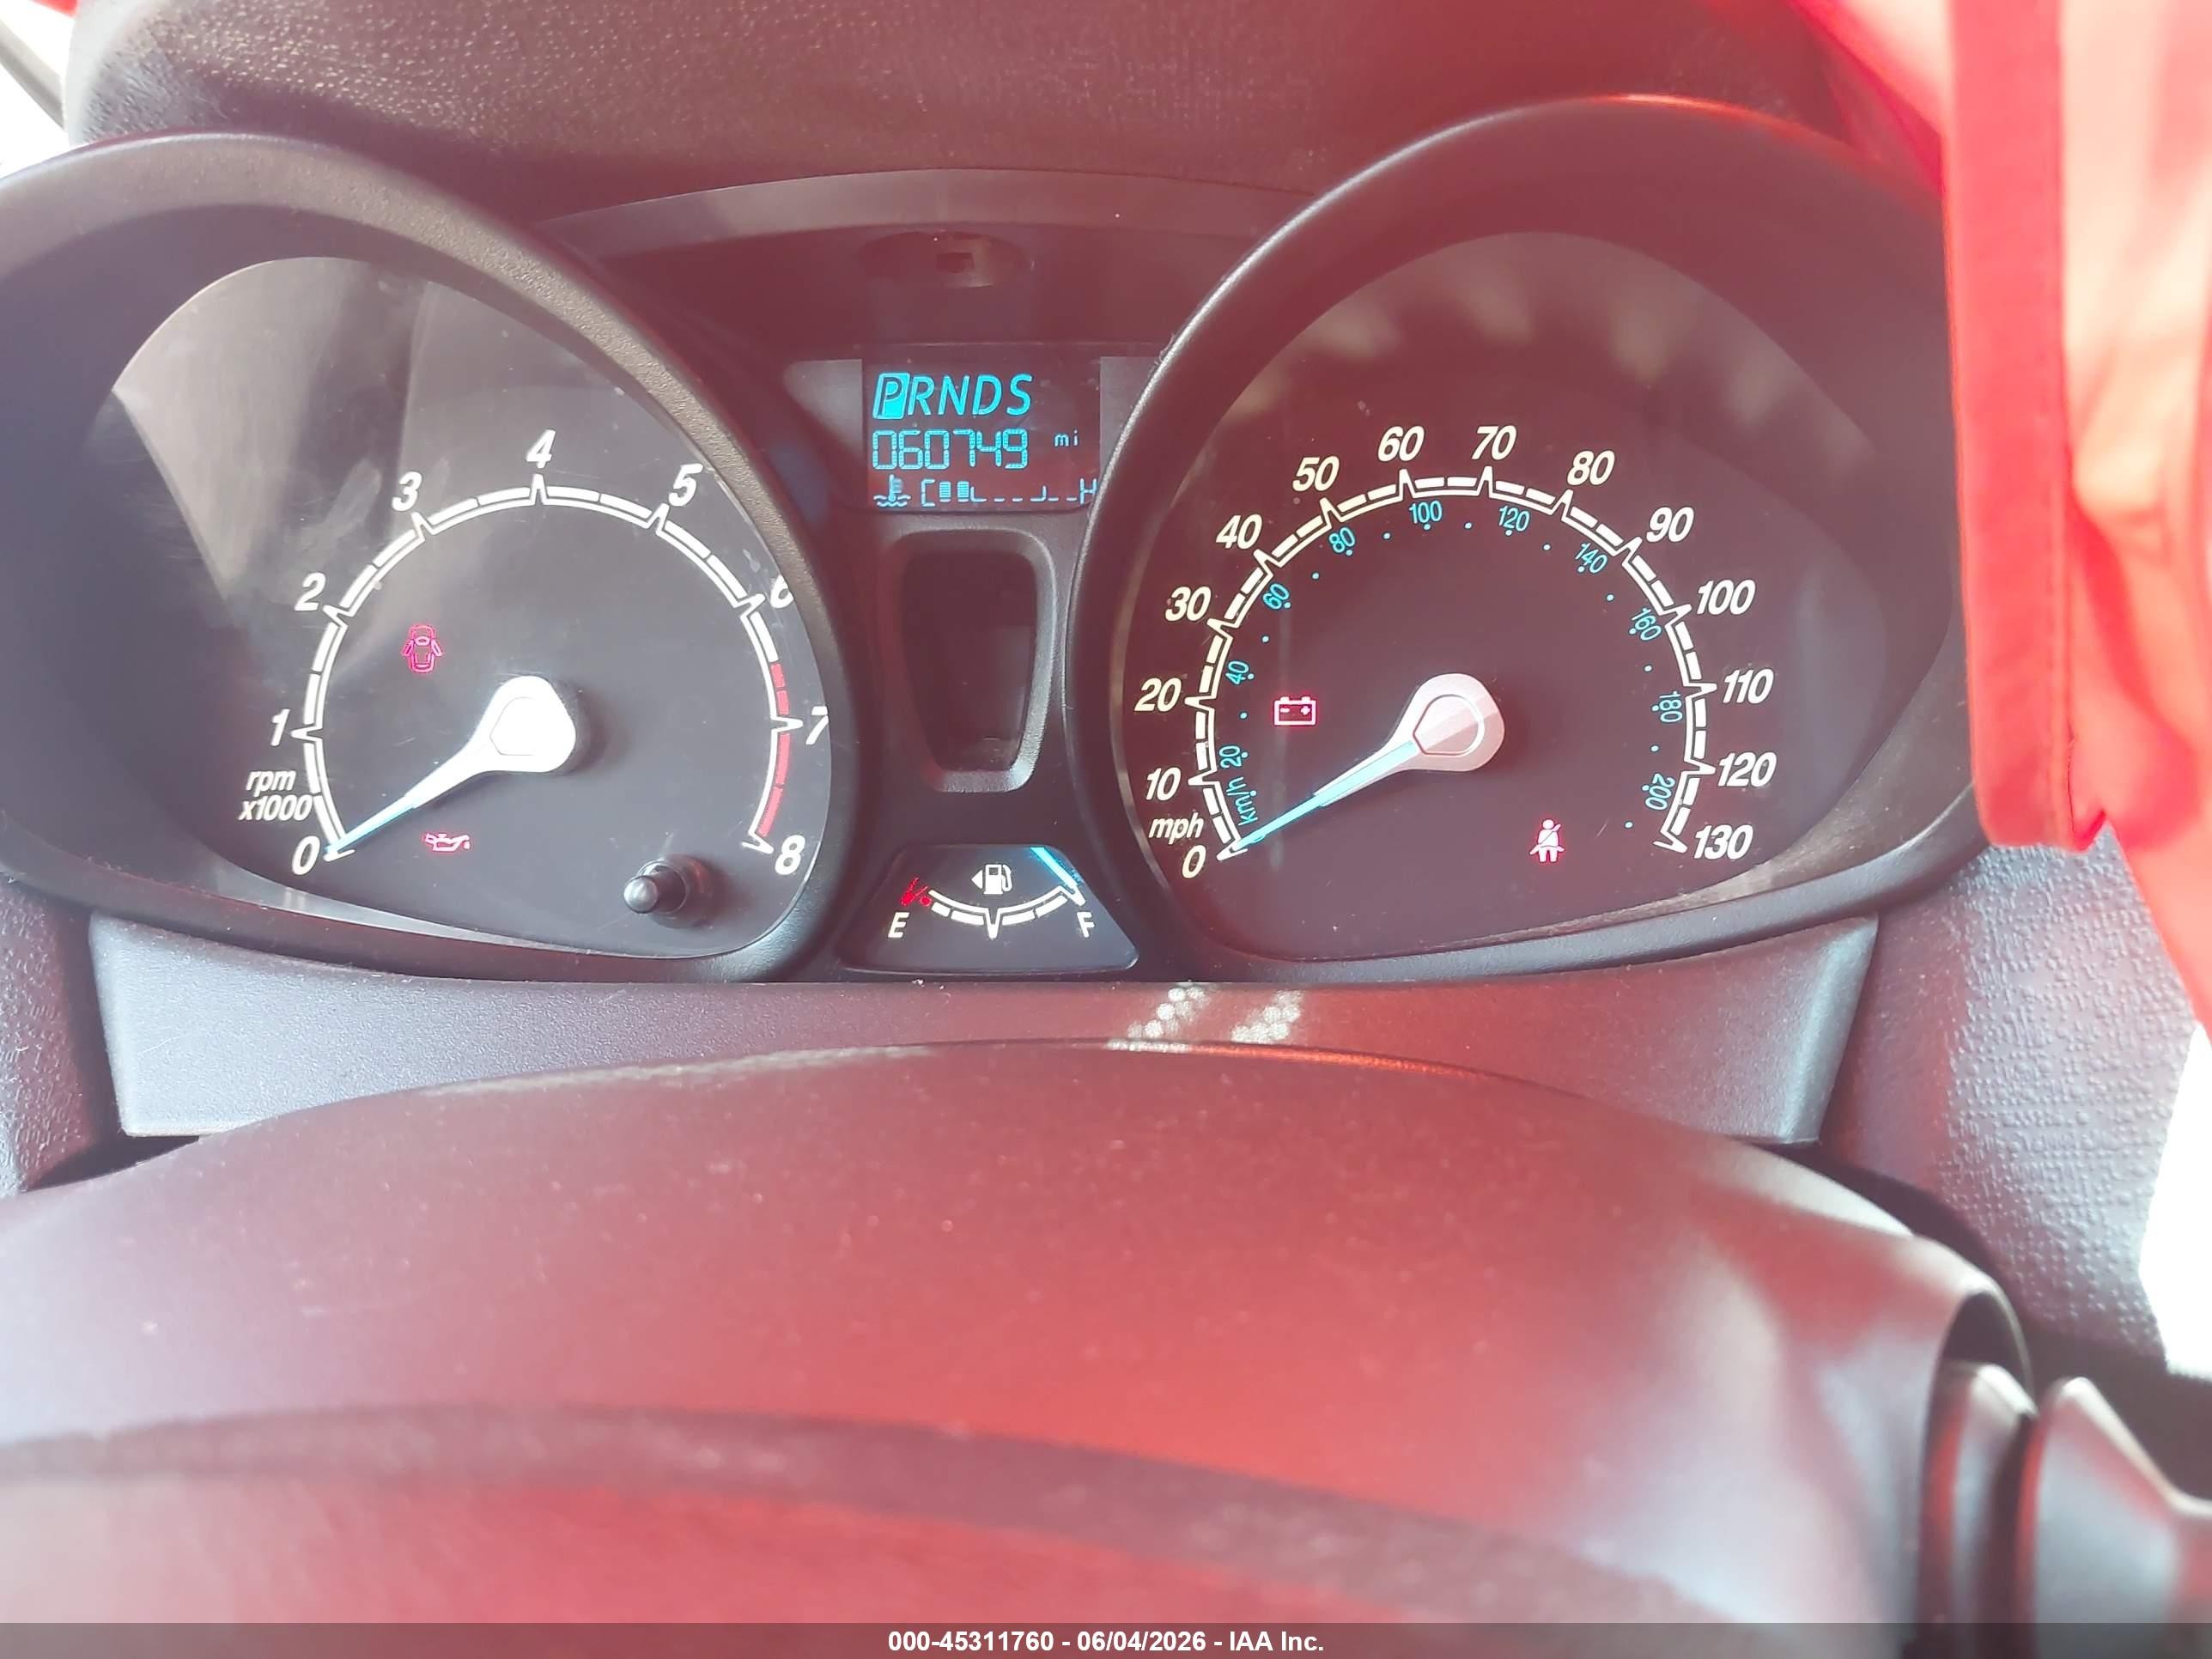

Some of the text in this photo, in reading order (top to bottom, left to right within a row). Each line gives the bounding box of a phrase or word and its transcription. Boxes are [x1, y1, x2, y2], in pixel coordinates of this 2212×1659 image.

[526, 429, 556, 468] 4
[872, 428, 1079, 470] 060749 mi
[1377, 426, 1425, 462] 60
[1471, 425, 1517, 460] 70
[668, 464, 703, 506] 5
[1292, 456, 1340, 492] 50
[1566, 450, 1615, 486] 80
[392, 471, 422, 512] 3
[1408, 500, 1443, 524] 100
[1498, 505, 1531, 532] 120
[1646, 506, 1694, 543] 90
[1216, 514, 1262, 550] 40
[1328, 526, 1356, 554] 80
[1575, 542, 1607, 574] 140
[295, 573, 325, 611] 2
[1164, 586, 1212, 622] 30
[1261, 583, 1290, 611] 60
[1696, 579, 1756, 616] 100
[1632, 607, 1662, 641] 160
[1225, 660, 1249, 685] 40
[1723, 668, 1774, 704] 110
[1133, 677, 1182, 712] 20
[1658, 691, 1683, 723] 180
[270, 708, 289, 745] 1
[805, 706, 829, 744] 7
[1218, 744, 1242, 769] 20
[1717, 751, 1778, 787] 120
[246, 770, 295, 795] rpm
[1146, 767, 1182, 801] 10
[1645, 773, 1675, 811] 200
[239, 795, 313, 821] x1000
[1225, 776, 1258, 826] km/h
[1148, 812, 1204, 844] mph
[1693, 824, 1753, 860] 130
[292, 836, 320, 874] 0
[774, 836, 805, 875] 8
[1181, 845, 1206, 878] 0
[888, 911, 909, 938] E
[1077, 911, 1095, 938] F
